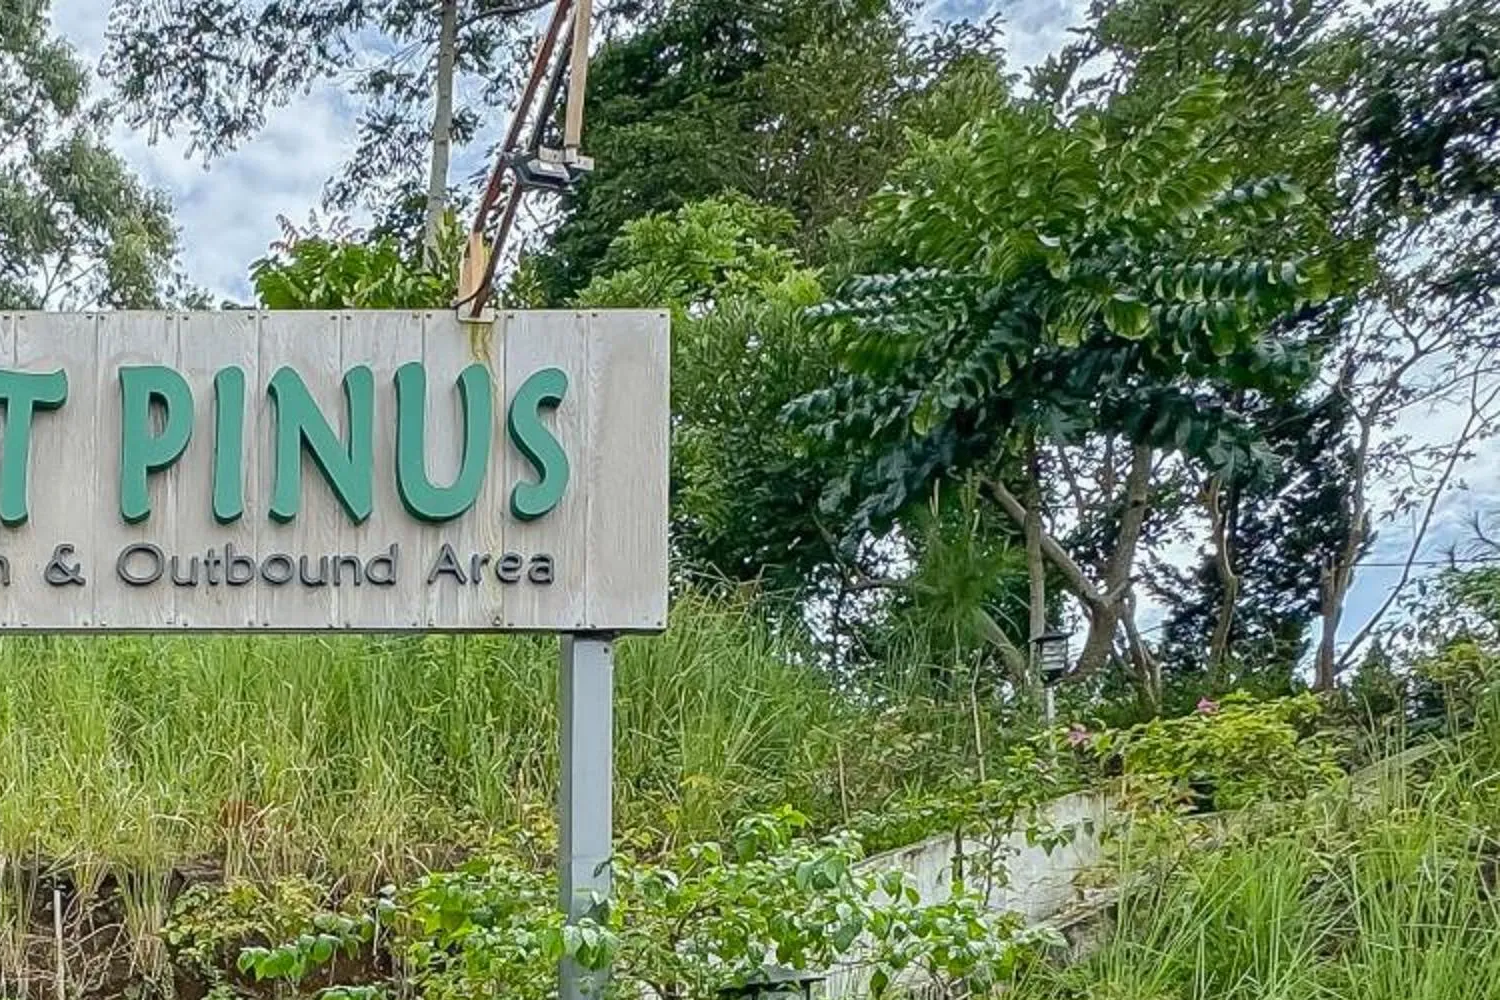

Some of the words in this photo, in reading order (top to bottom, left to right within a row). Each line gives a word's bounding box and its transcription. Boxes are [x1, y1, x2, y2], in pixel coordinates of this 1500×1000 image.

[117, 361, 570, 525] PINUS
[43, 543, 86, 588] &
[116, 542, 398, 588] Outbound
[427, 543, 556, 588] Area
